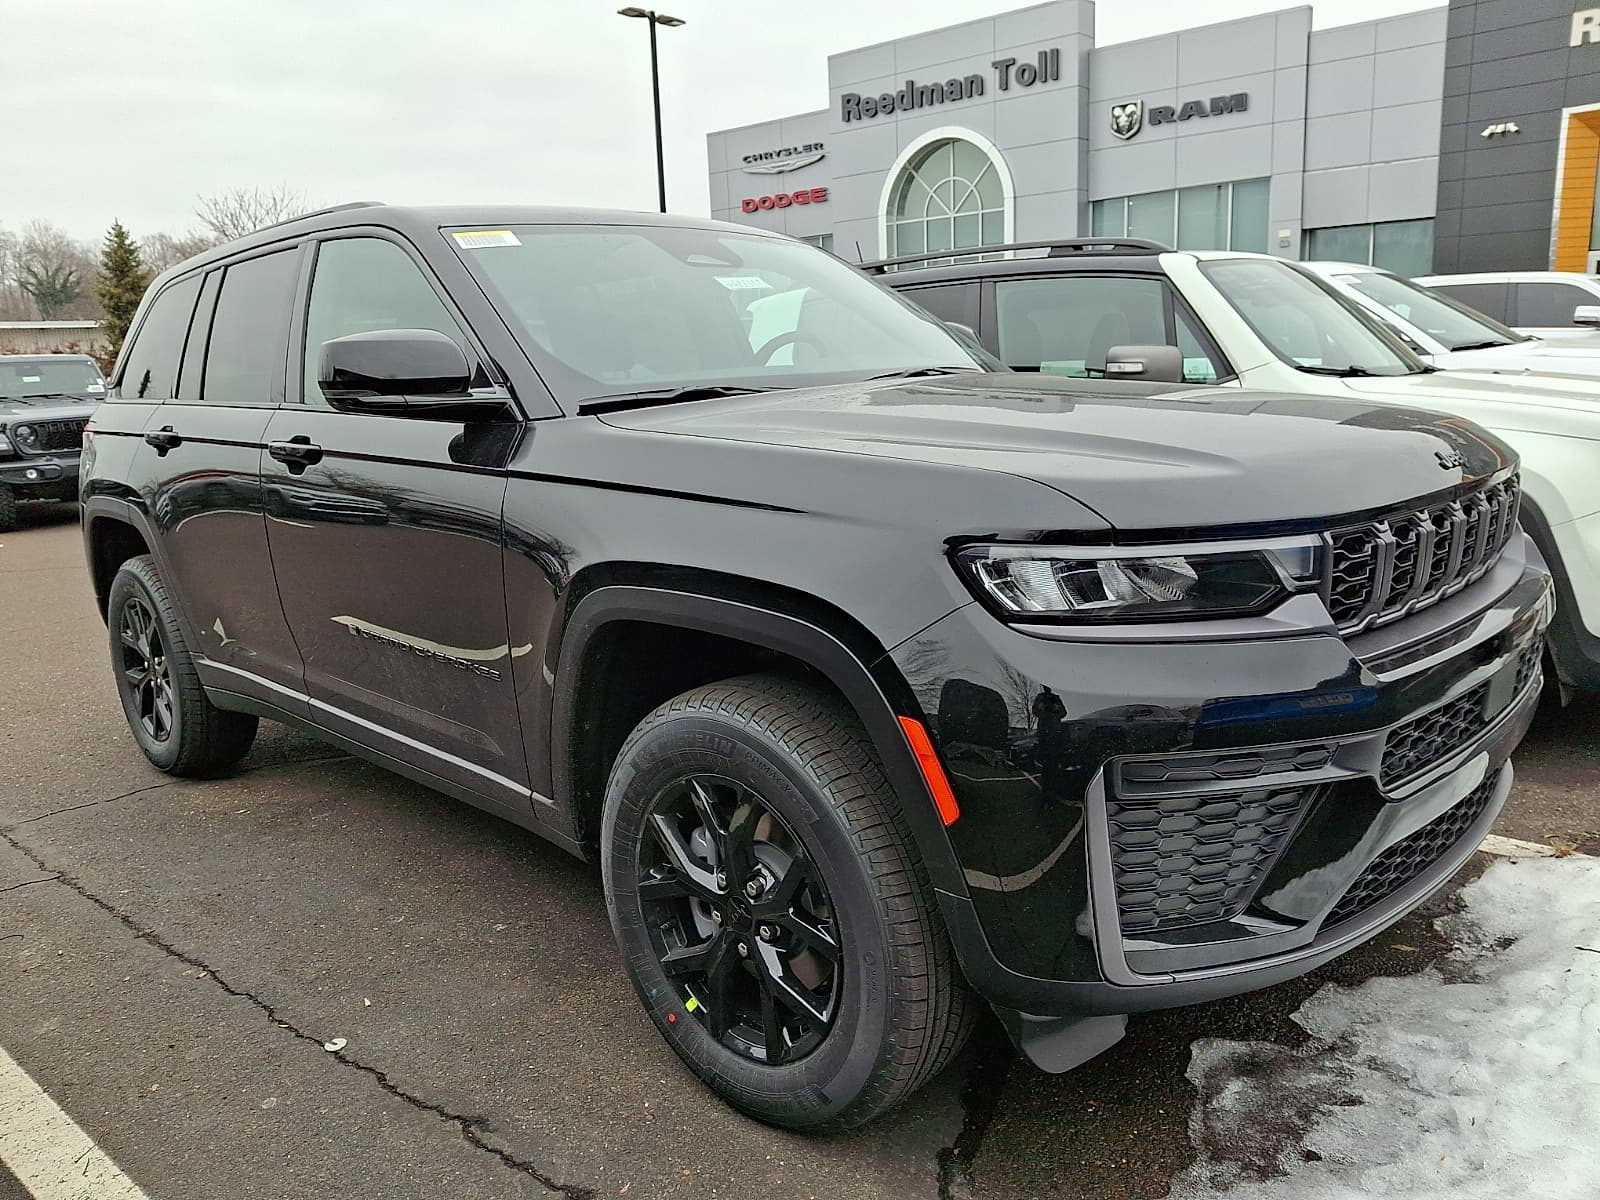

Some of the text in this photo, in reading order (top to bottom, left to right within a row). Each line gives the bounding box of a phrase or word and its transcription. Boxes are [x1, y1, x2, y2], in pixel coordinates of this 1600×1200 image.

[840, 48, 1060, 123] Reedman Toll
[1148, 92, 1248, 126] RAM
[743, 142, 825, 164] CHRYSLER
[742, 187, 828, 214] DODGE
